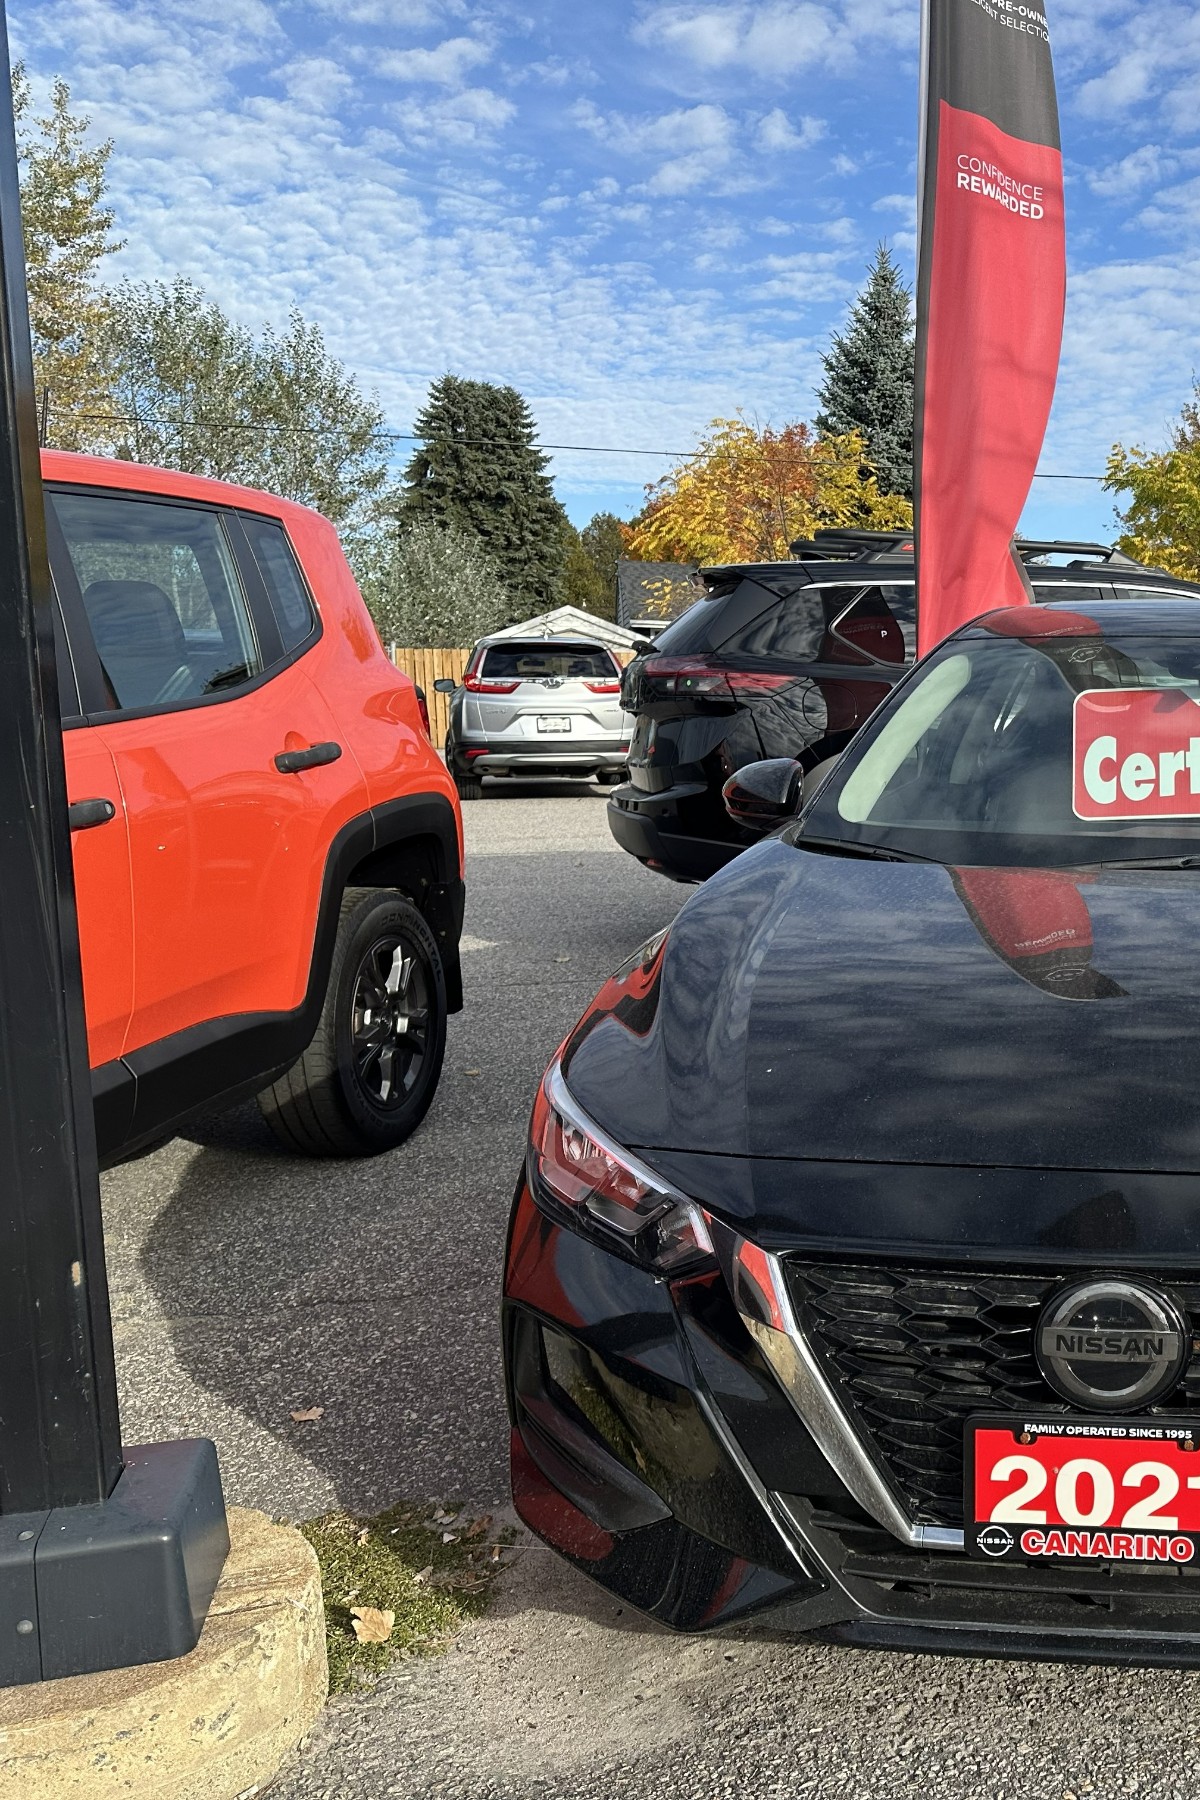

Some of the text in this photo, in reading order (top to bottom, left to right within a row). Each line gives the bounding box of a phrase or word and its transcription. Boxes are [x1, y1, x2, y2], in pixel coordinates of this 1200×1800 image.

[1000, 14, 1050, 42] SELECTIO
[957, 154, 1043, 202] CONFIDENCE
[957, 172, 1044, 220] REWARDED
[1055, 1334, 1164, 1356] NISSAN
[1023, 1423, 1193, 1439] FAMILY OPERATED SINCE 1995
[976, 1536, 1015, 1545] NISSAN
[1020, 1529, 1195, 1563] CANARINO
